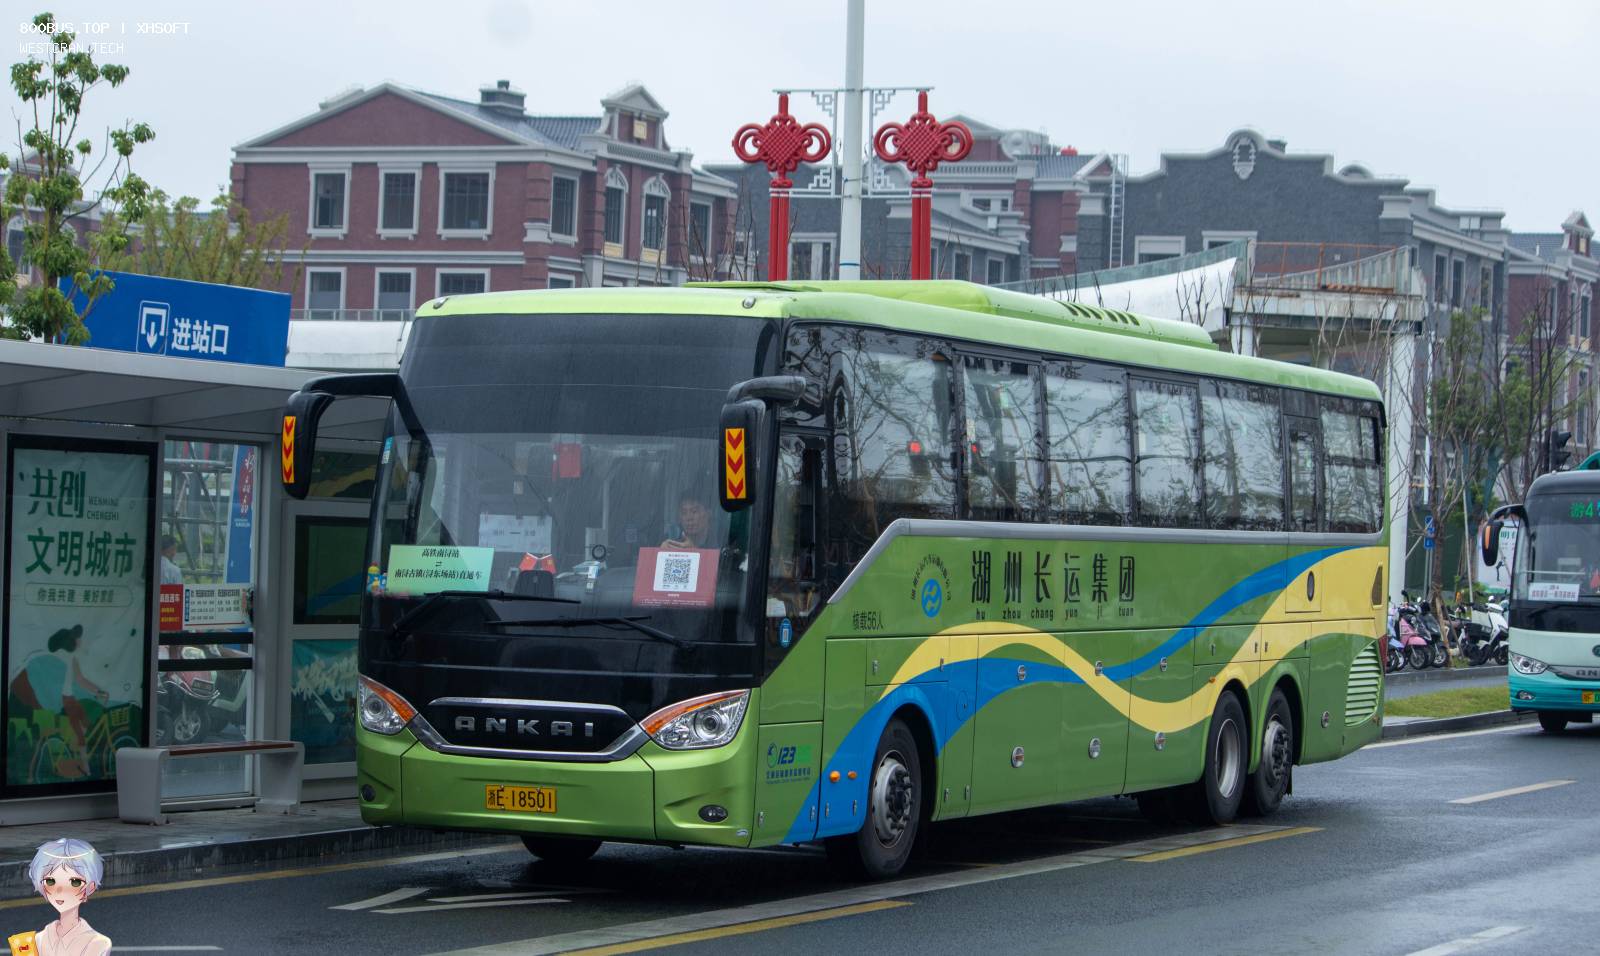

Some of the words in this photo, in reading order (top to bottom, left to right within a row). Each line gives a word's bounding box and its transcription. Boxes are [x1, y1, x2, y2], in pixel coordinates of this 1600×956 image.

[171, 317, 229, 355] 进站口
[28, 467, 86, 519] 共创
[87, 510, 119, 521] CHENGSHI
[25, 527, 137, 578] 文明城市
[421, 548, 460, 559] 高铁南浔站
[971, 550, 1136, 604] 湖州长运集团
[975, 608, 986, 620] hu
[1002, 608, 1021, 620] zhou
[1030, 608, 1054, 622] chang
[1064, 608, 1079, 622] yun
[1118, 606, 1134, 617] tuan
[454, 715, 594, 738] ANKAI
